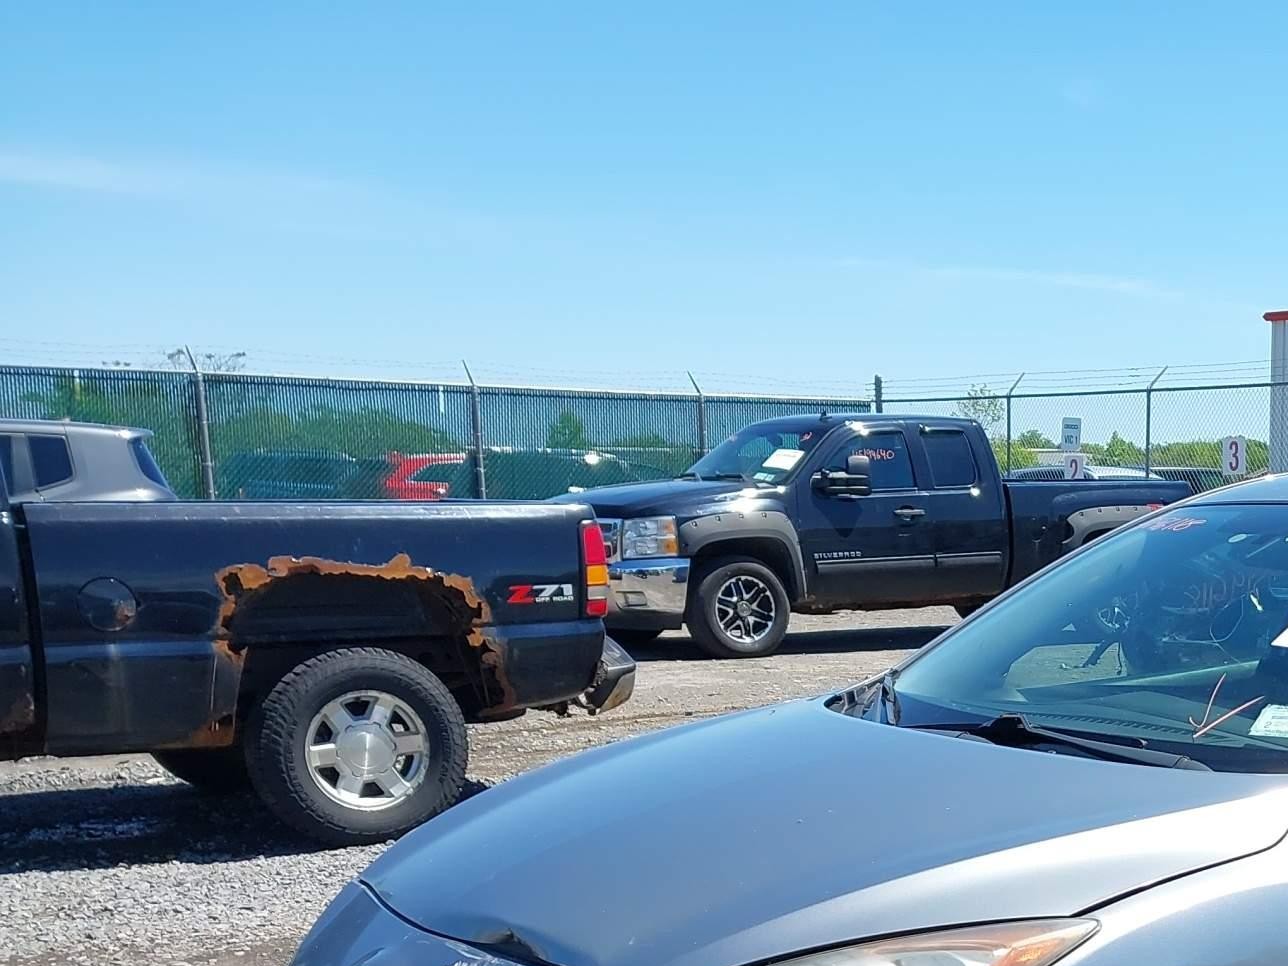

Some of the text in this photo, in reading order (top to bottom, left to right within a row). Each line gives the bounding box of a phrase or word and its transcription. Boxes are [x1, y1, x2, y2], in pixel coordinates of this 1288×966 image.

[1228, 440, 1240, 472] 3
[1069, 458, 1079, 480] 2
[507, 583, 573, 603] Z71
